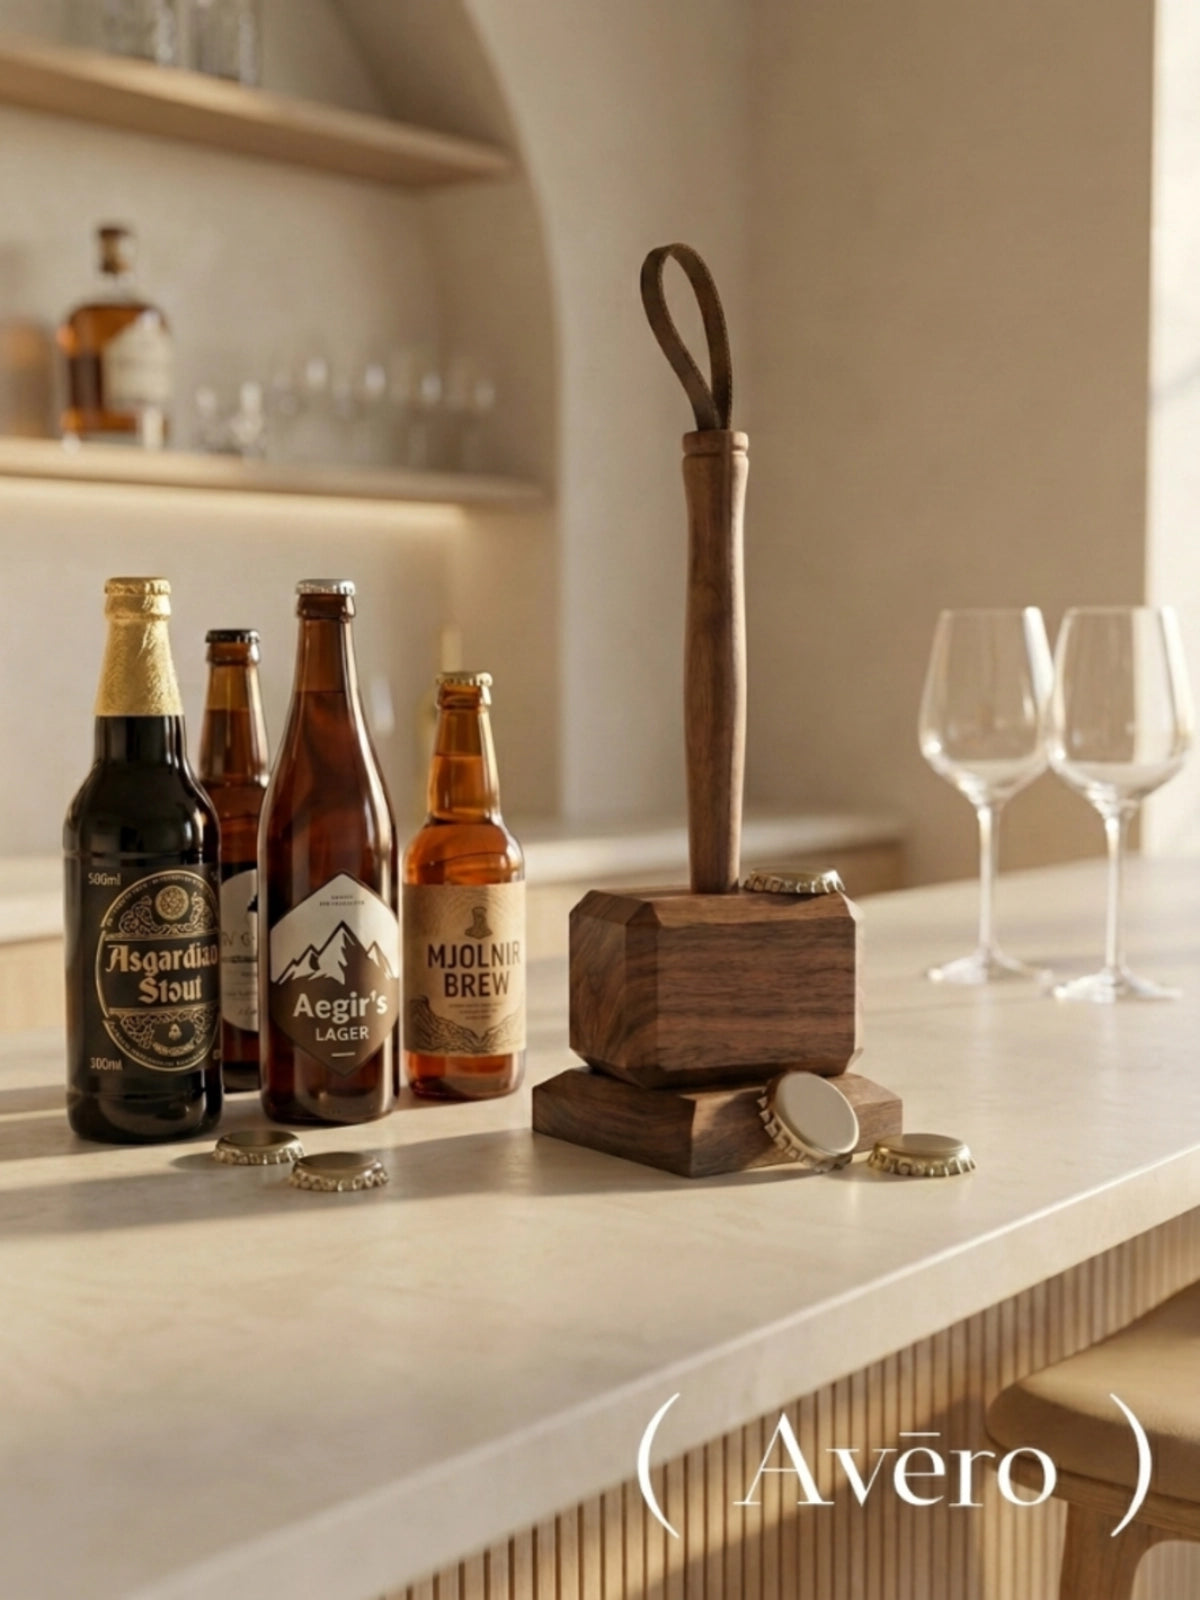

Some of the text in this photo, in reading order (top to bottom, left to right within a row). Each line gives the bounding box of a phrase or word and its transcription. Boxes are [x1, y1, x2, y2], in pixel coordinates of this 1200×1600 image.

[427, 941, 521, 969] MJOLNIR
[138, 975, 203, 1004] Stout
[444, 971, 510, 998] BREW
[293, 990, 389, 1024] Aegir's
[315, 1026, 370, 1042] LAGER
